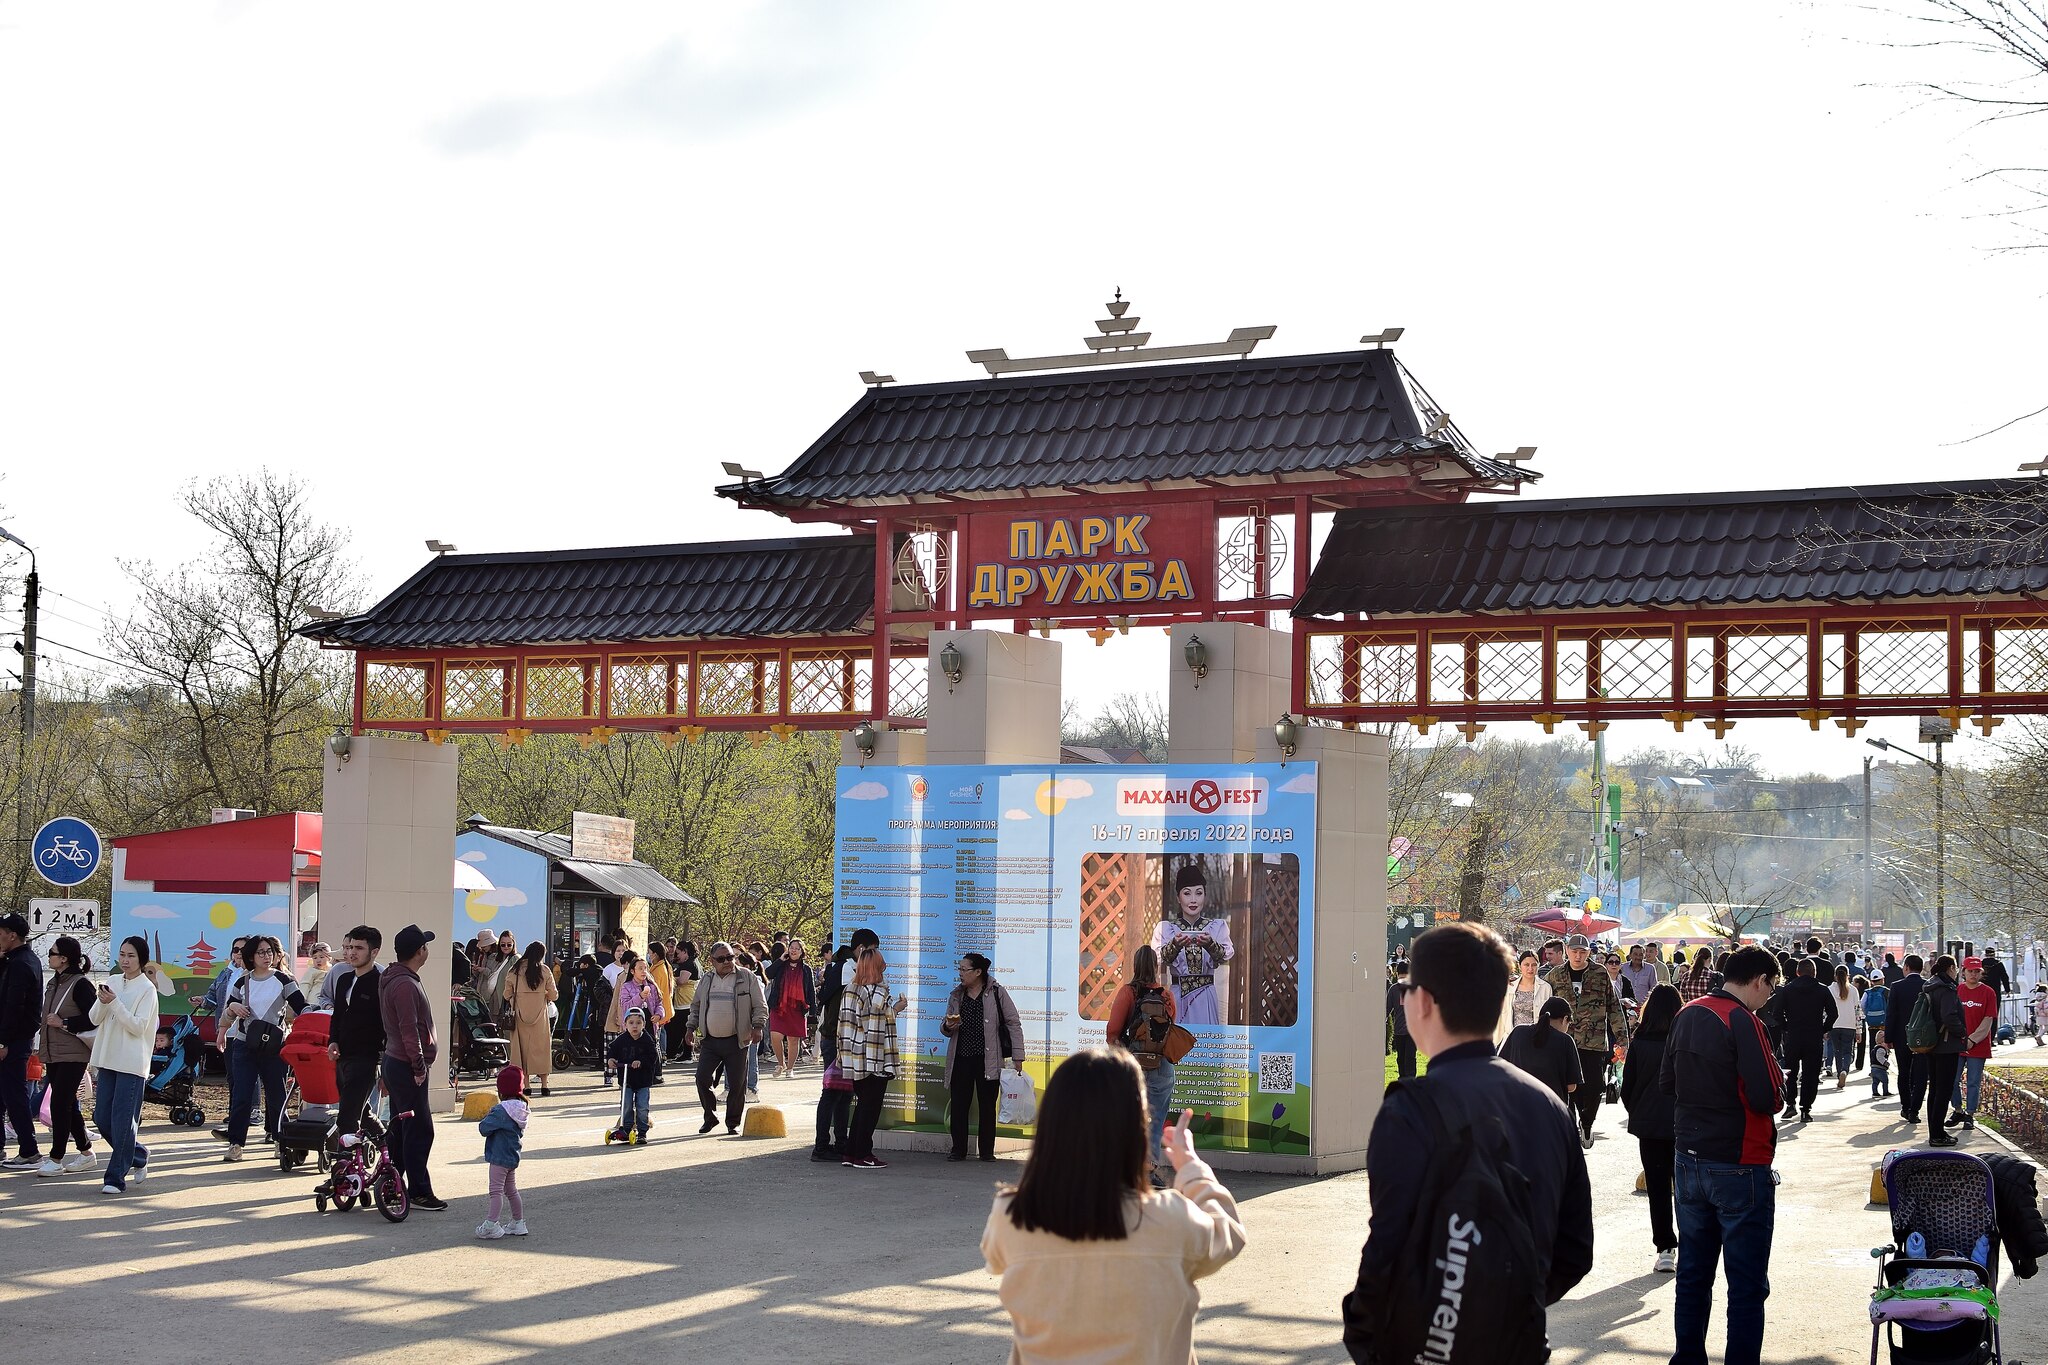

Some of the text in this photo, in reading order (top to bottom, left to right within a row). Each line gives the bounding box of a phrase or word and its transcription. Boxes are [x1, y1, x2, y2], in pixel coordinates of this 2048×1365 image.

[1009, 514, 1150, 560] ПАРК
[968, 559, 1195, 608] ДРУЖБА
[1123, 789, 1187, 805] МАХАН
[1223, 789, 1262, 805] FEST
[888, 819, 936, 830] ПРОГРАММА
[1091, 824, 1294, 845] 16-17 апреля 2022 года
[52, 909, 61, 923] 2
[1078, 1026, 1105, 1036] Гастрон
[1203, 1042, 1254, 1051] празднования
[1189, 1051, 1248, 1059] идеи фестиваля
[1209, 1071, 1240, 1079] туризма,
[1197, 1080, 1241, 1088] республики.
[1184, 1098, 1215, 1106] столицы
[1423, 1212, 1482, 1363] Suprem
